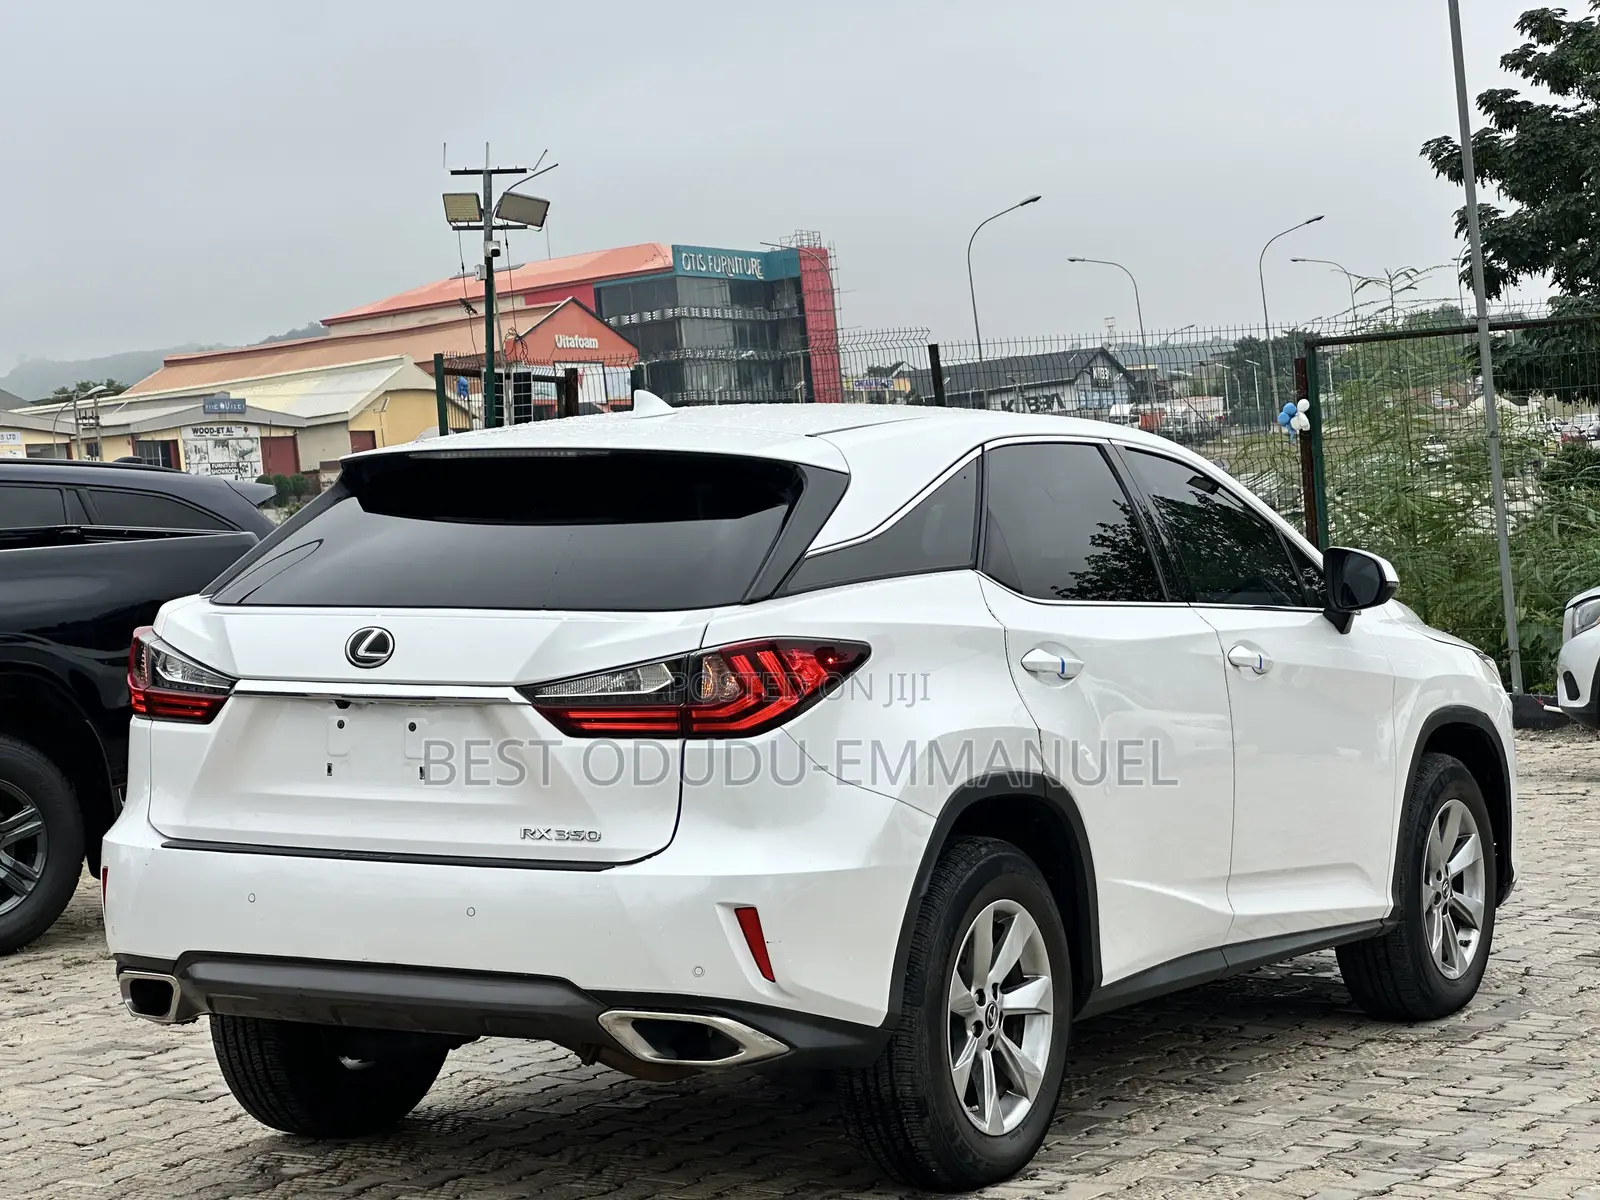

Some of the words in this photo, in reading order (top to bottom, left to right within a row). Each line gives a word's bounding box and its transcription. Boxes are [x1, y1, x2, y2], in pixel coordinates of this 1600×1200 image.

[682, 252, 706, 272] OTIS
[708, 254, 764, 279] FURNITURE
[520, 827, 553, 841] RX
[553, 828, 602, 843] 350
